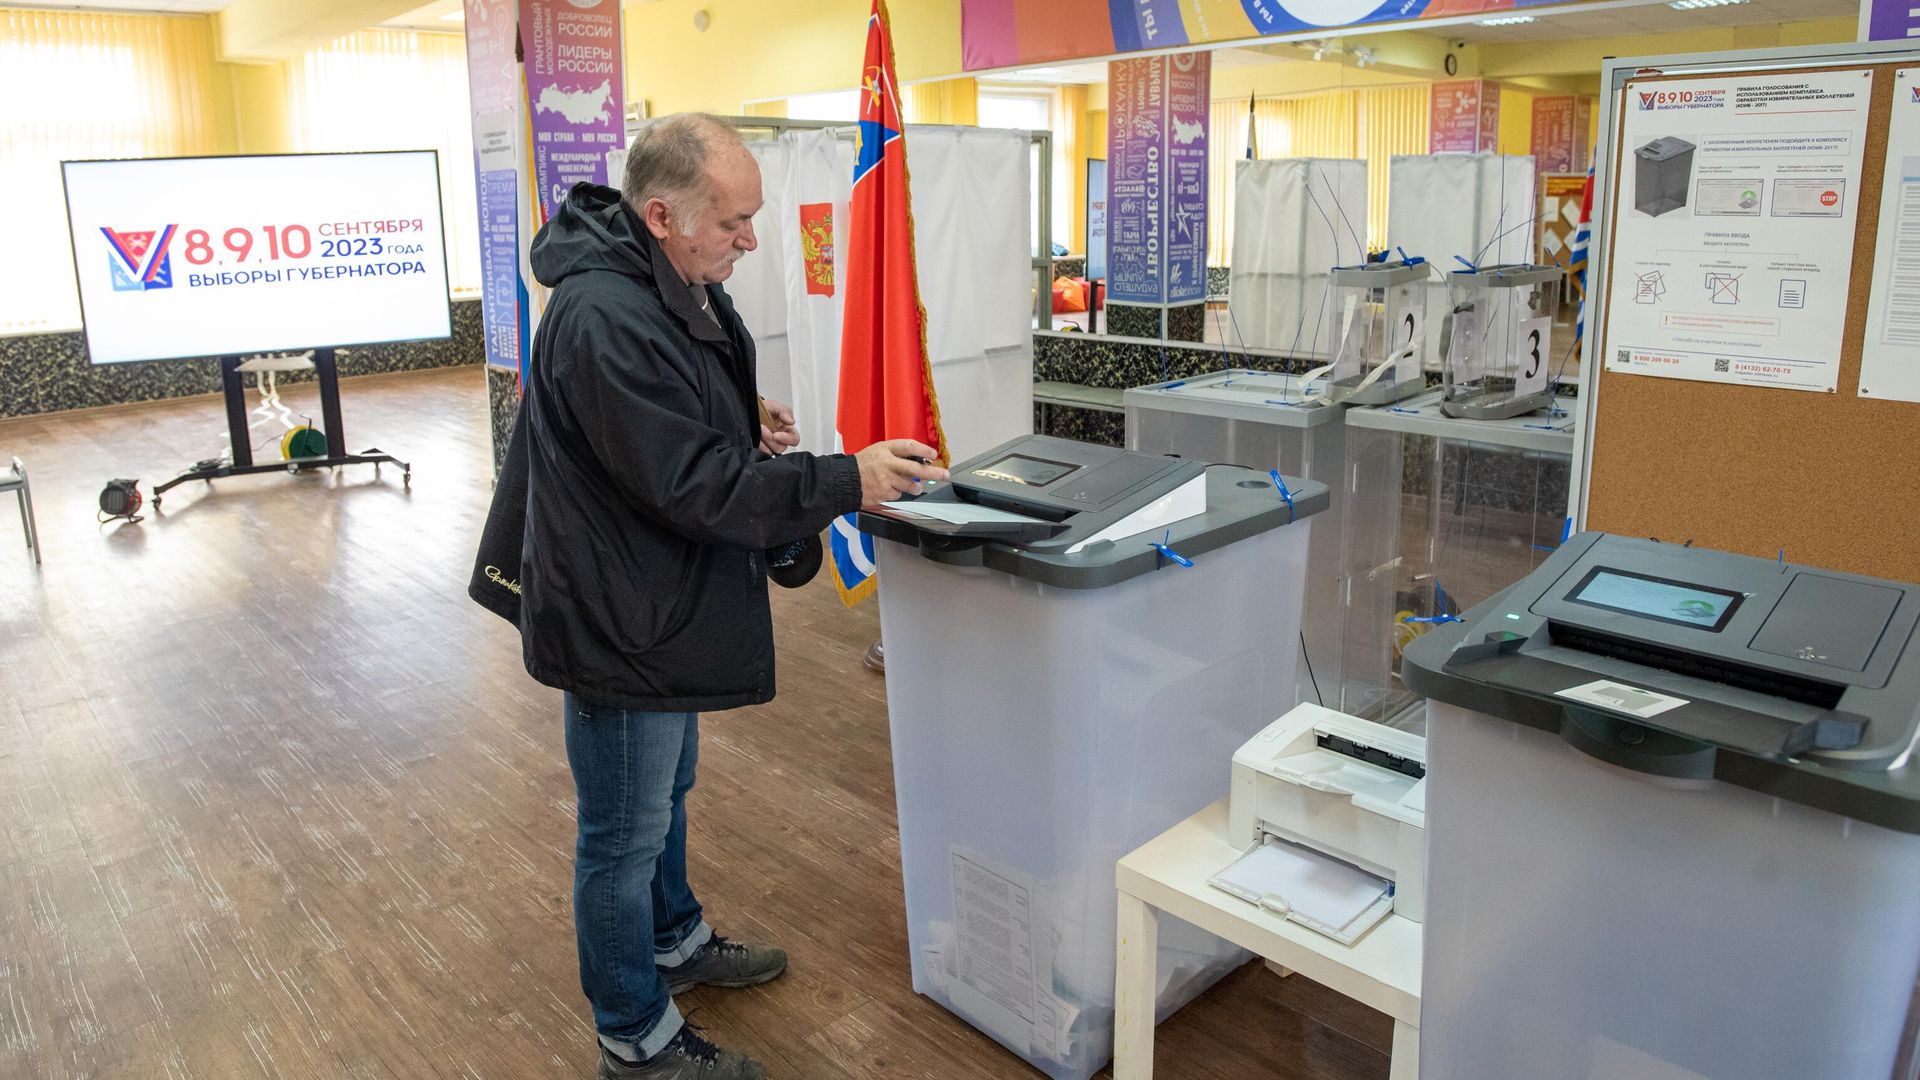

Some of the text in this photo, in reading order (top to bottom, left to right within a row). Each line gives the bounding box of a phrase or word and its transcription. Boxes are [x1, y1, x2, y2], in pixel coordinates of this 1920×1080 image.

[557, 12, 612, 24] ДОБРОВОЛЕЦ
[530, 2, 545, 74] ГРАНТОВЫЙ
[558, 22, 612, 38] РОССИИ
[558, 44, 612, 60] ЛИДЕРЫ
[558, 60, 613, 74] РОССИИ
[318, 219, 424, 237] СЕНТЯБРЯ
[320, 238, 424, 258] 2023 ГОДА
[189, 260, 426, 288] ВЫБОРЫ ГУБЕРНАТОРА
[484, 238, 498, 355] ТАЛАНТЛИВАЯ
[1525, 329, 1540, 378] 3
[1740, 364, 1761, 372] (4132)
